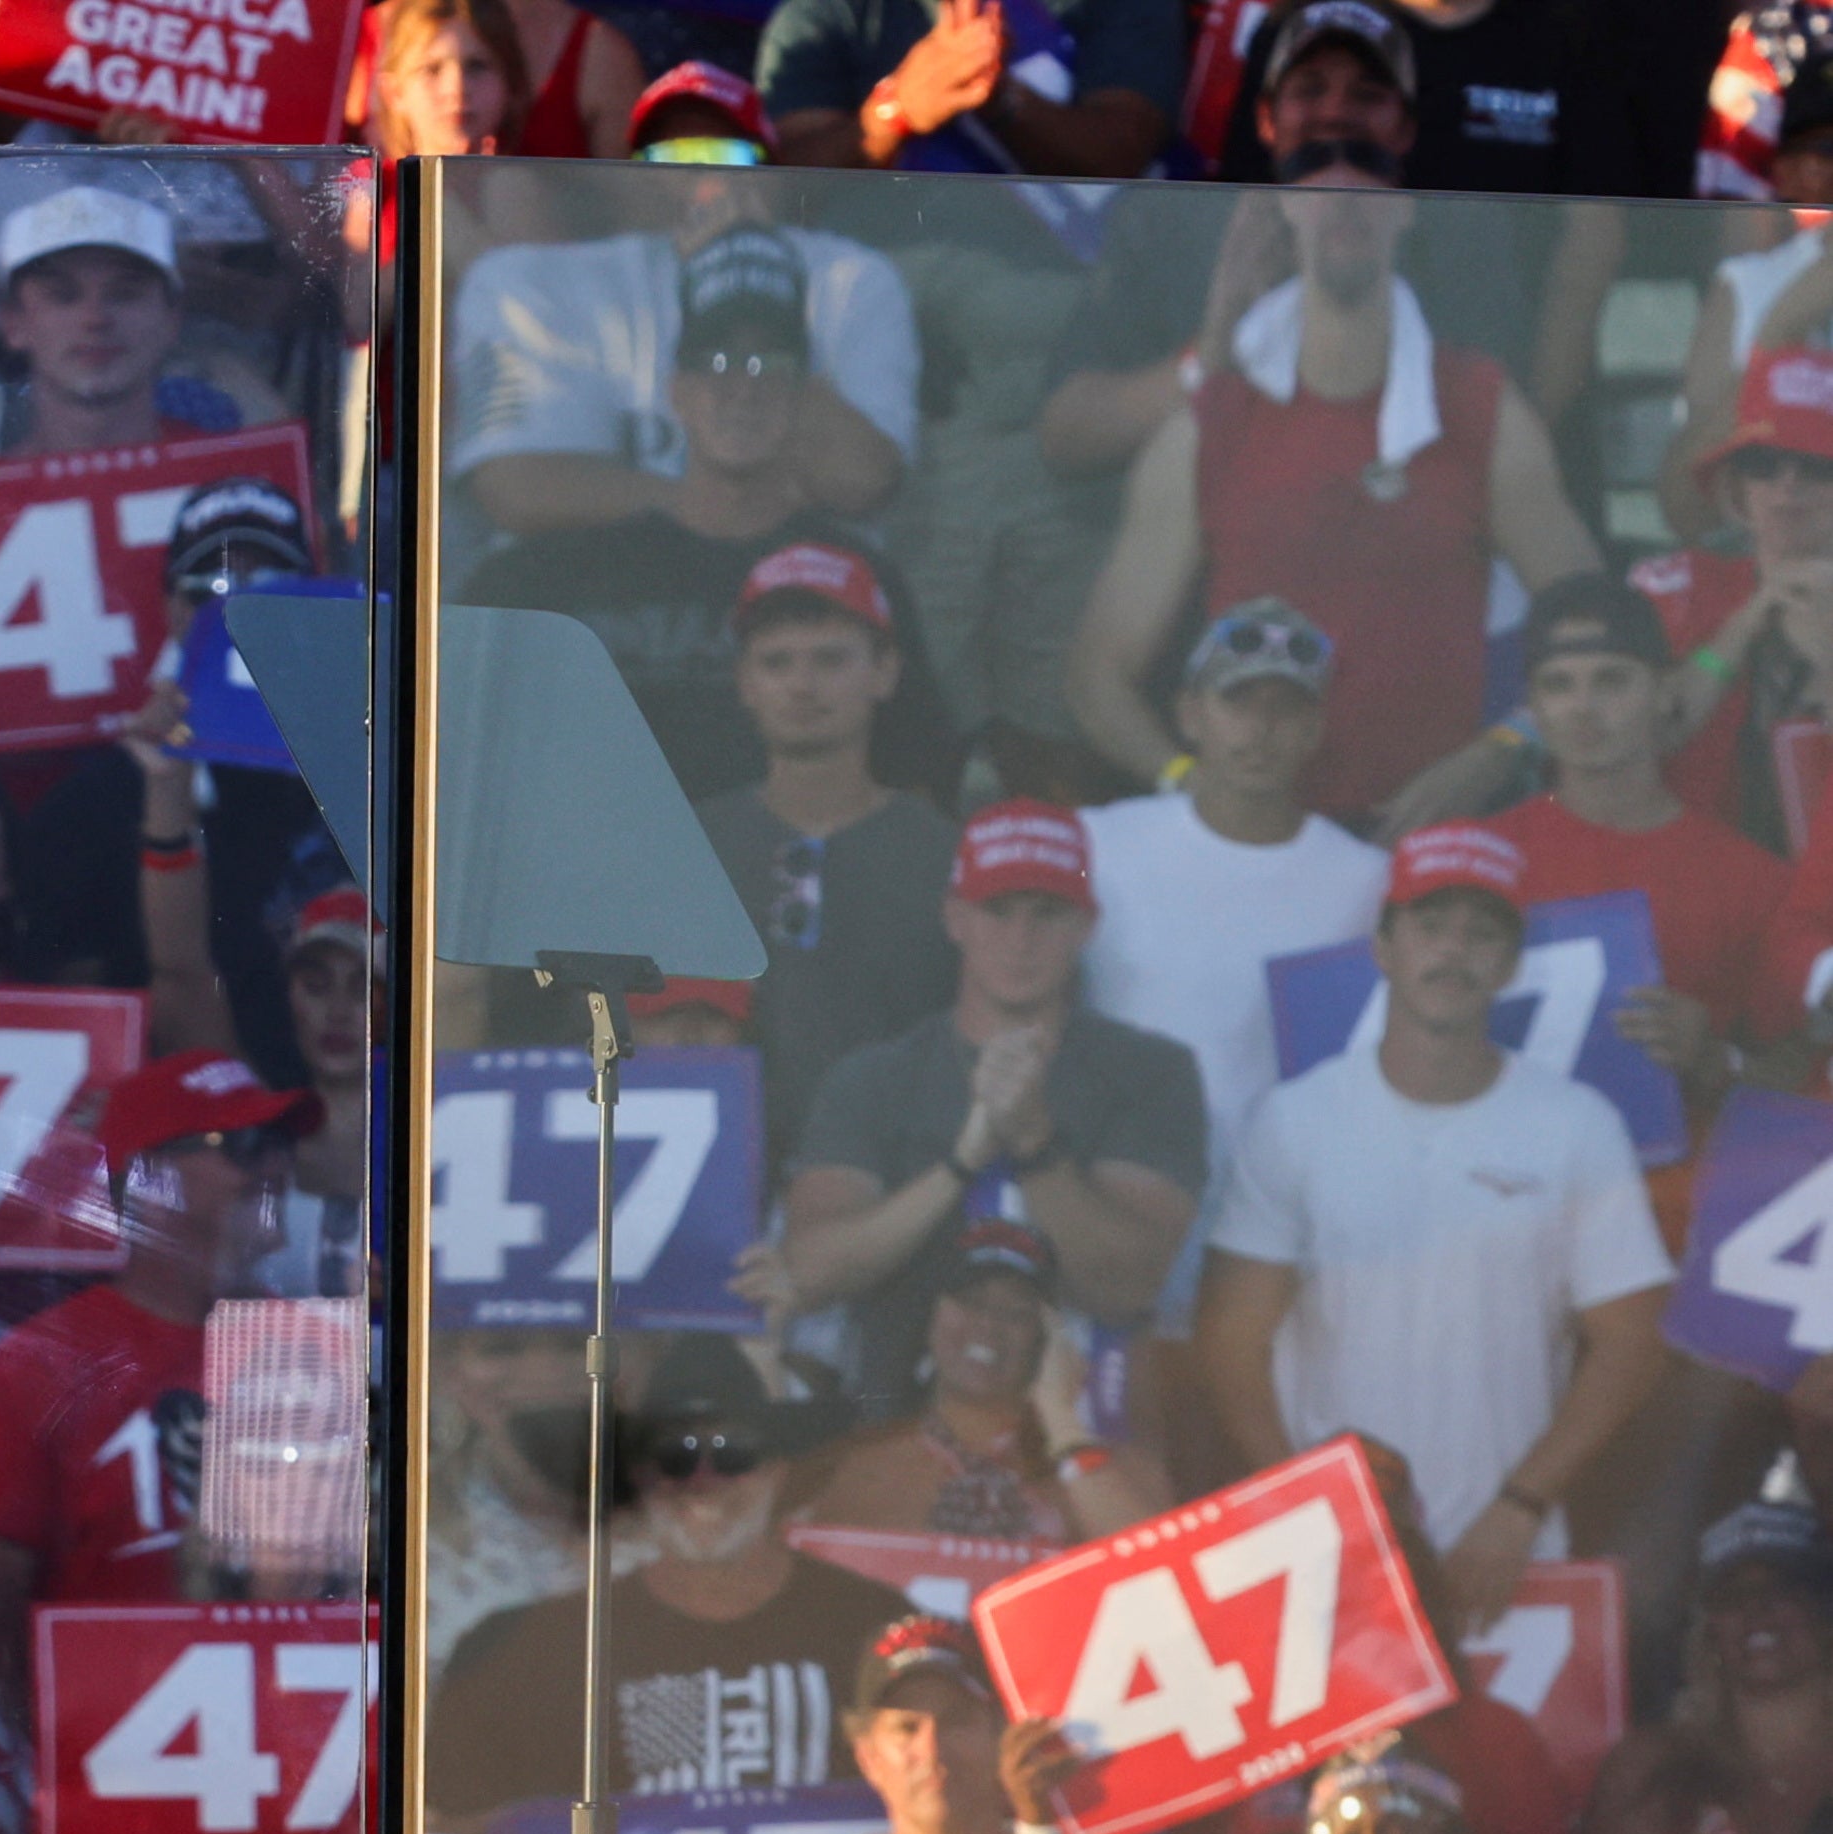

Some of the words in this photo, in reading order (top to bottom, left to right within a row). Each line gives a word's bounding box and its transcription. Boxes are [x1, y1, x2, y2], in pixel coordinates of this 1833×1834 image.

[43, 44, 268, 133] AGAIN!
[64, 0, 274, 82] GREAT
[433, 1088, 719, 1282] 47
[1061, 1496, 1342, 1761] 47
